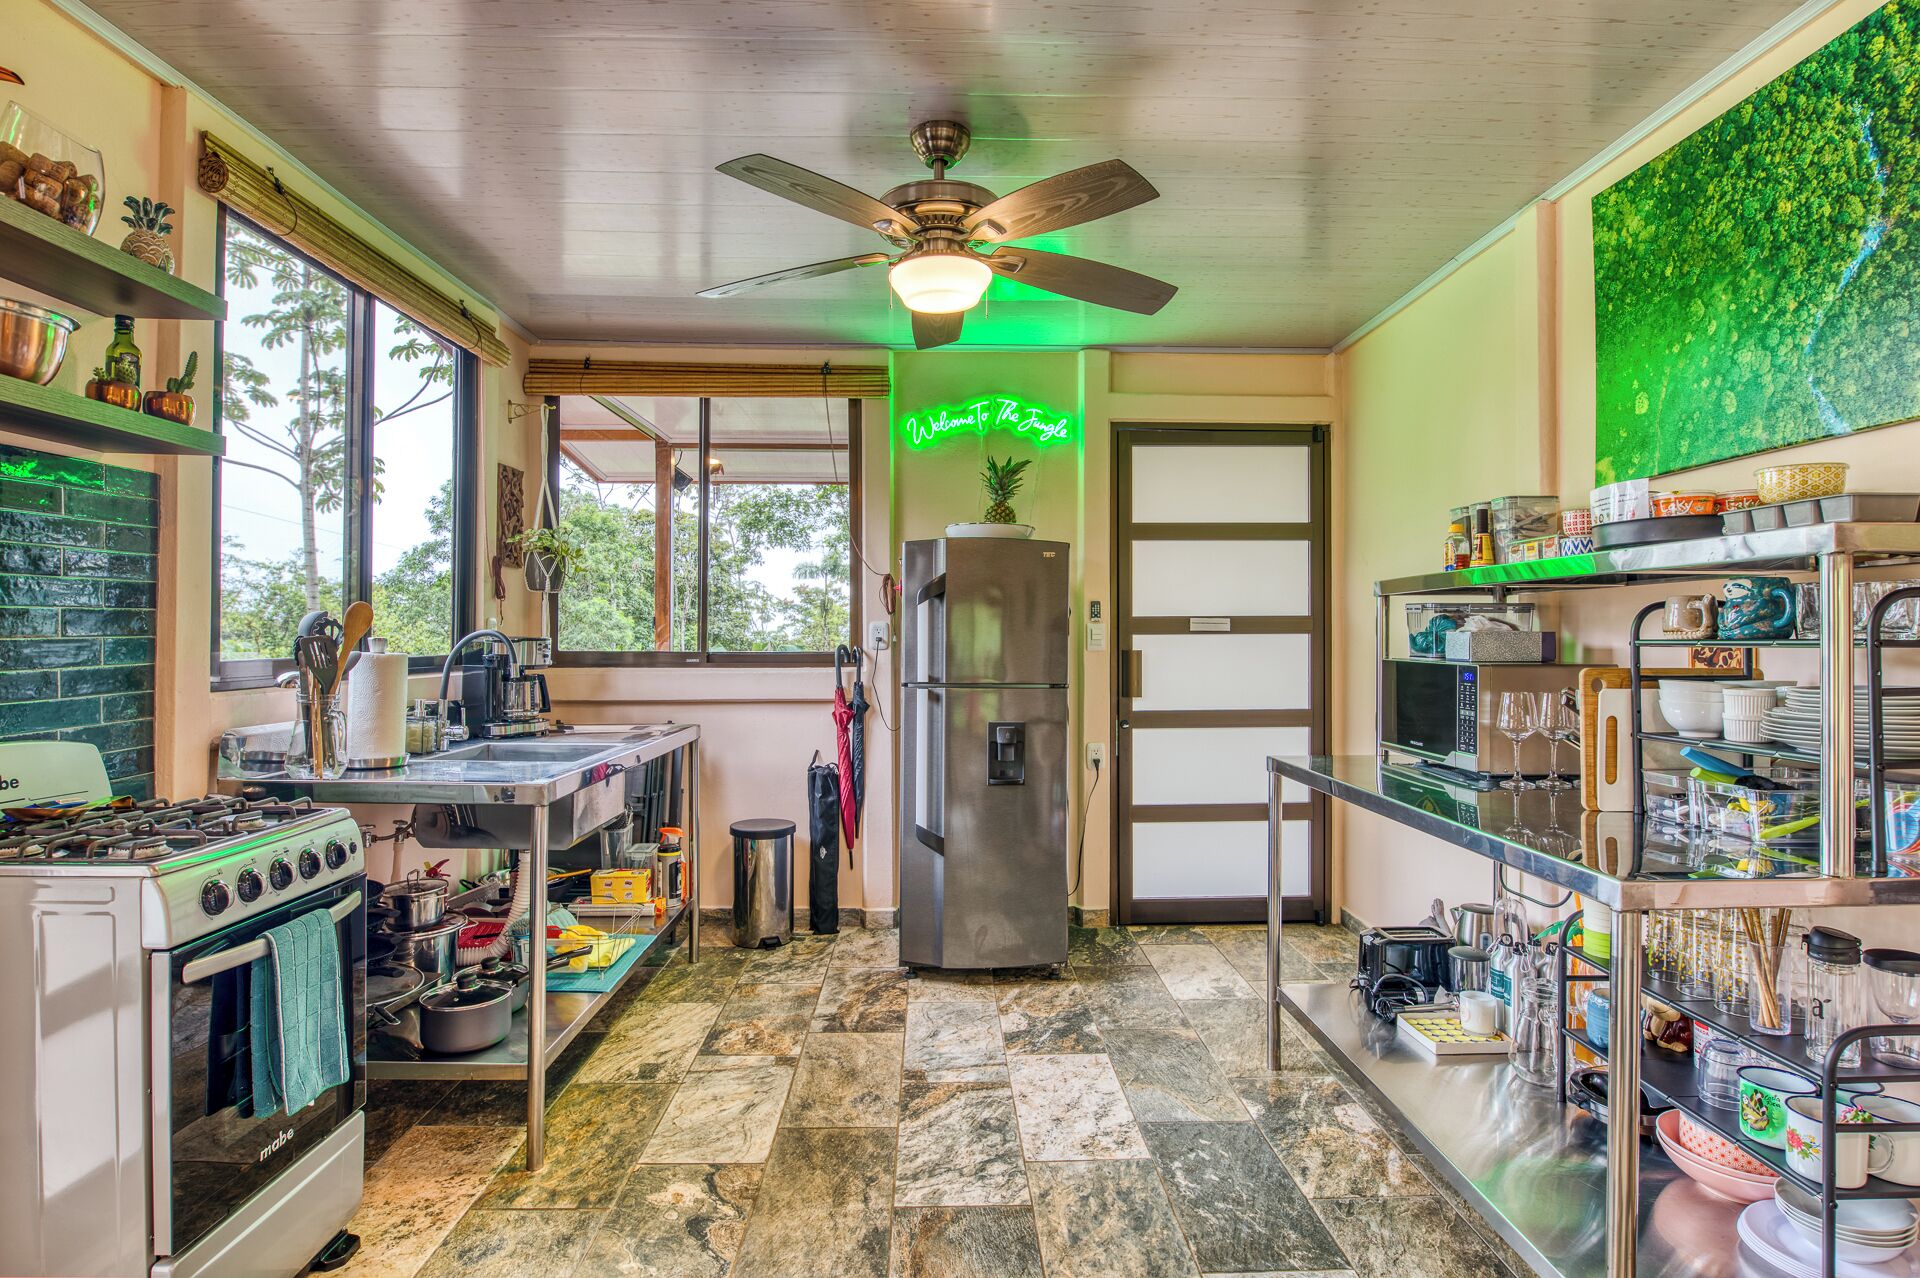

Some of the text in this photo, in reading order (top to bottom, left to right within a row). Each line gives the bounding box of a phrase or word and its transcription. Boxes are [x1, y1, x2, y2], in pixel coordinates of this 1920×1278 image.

[907, 398, 1068, 444] Welcome To The Jungle
[260, 1128, 295, 1162] mabe
